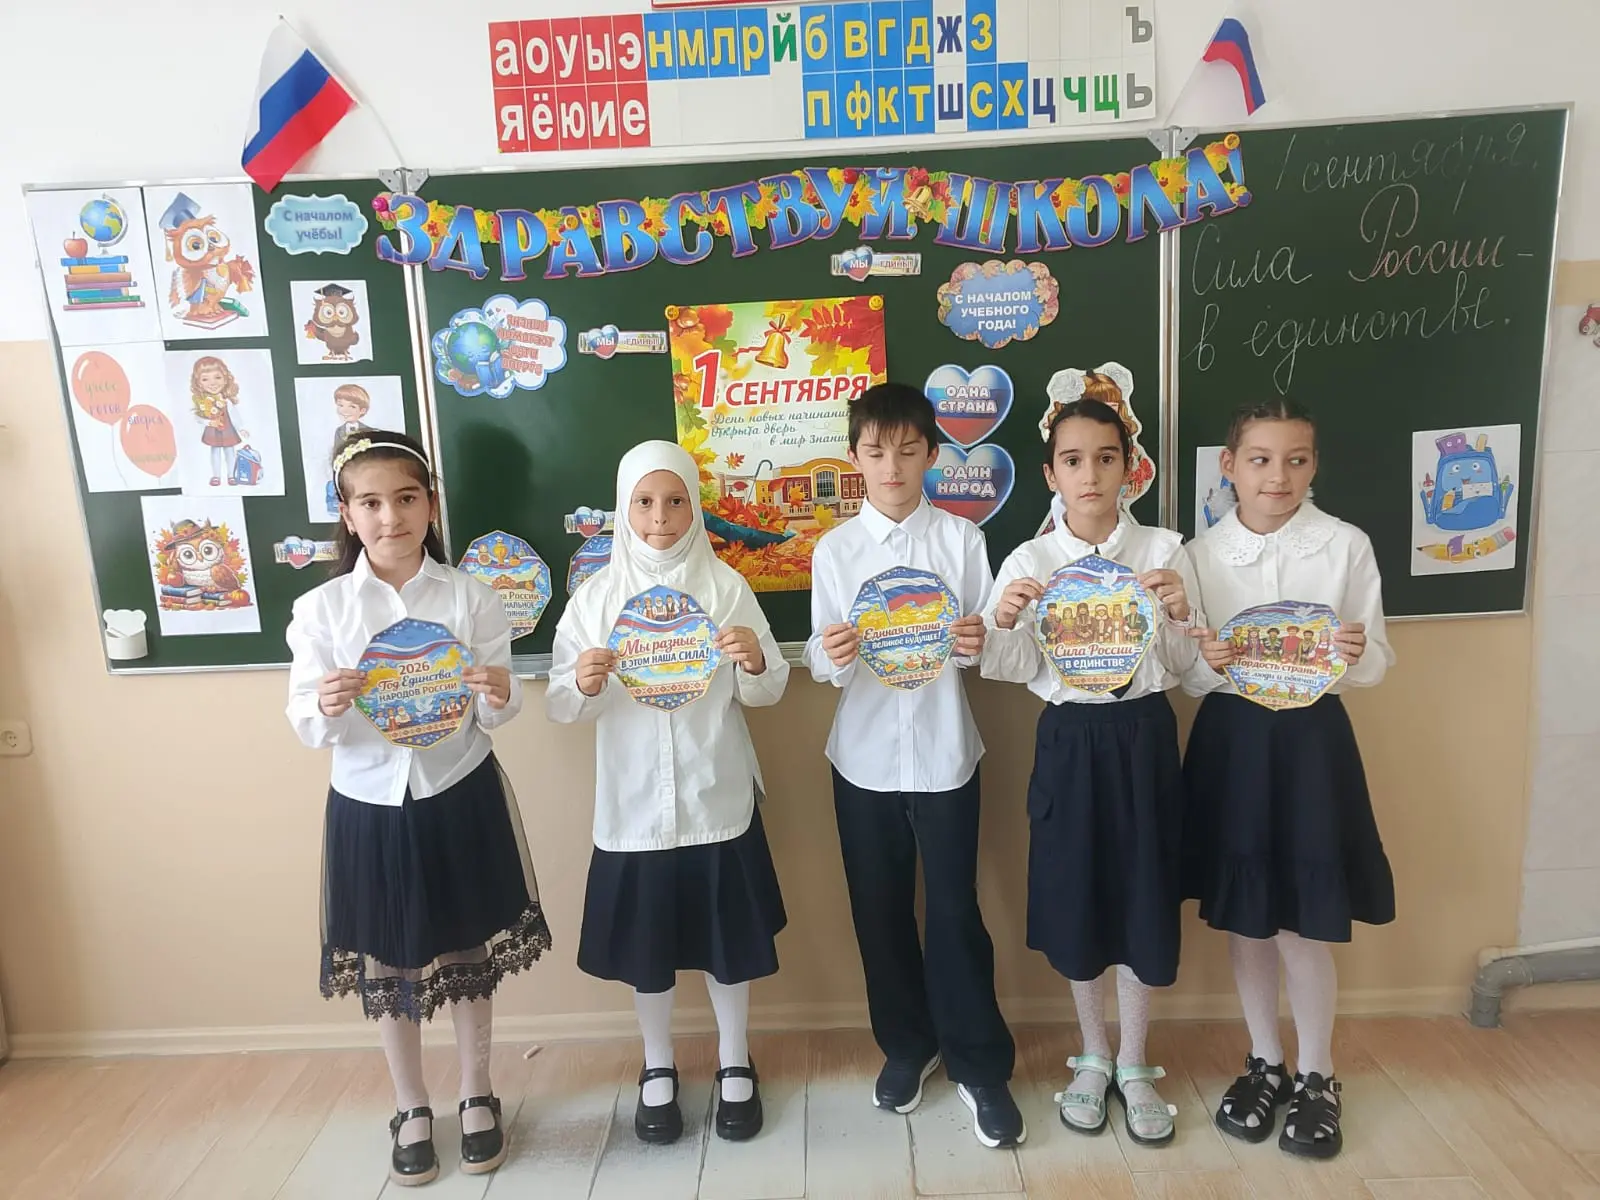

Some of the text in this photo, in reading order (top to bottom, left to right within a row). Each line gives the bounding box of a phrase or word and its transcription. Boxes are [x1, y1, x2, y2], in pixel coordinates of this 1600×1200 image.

[1275, 133, 1297, 191] 1
[284, 210, 354, 222] С началом
[377, 145, 1252, 281] ЗДРАВСТВУЙ ШКОЛА!
[296, 226, 343, 242] учёбы!
[1191, 223, 1313, 296] Сила
[1348, 183, 1504, 283] России
[850, 259, 868, 269] МЫ
[955, 290, 1032, 305] С НАЧАЛОМ
[960, 304, 1030, 318] УЧЕБНОГО
[978, 319, 1017, 332] ГОДА!
[596, 337, 615, 346] МЫ
[694, 352, 869, 408] 1 СЕНТЯБРЯ
[946, 385, 990, 398] ОДНА
[938, 399, 998, 413] СТРАНА
[711, 409, 850, 425] День новых начинани
[711, 421, 796, 440] Открыта дверь
[780, 437, 807, 448] мир
[809, 434, 850, 444] Знани
[942, 466, 991, 480] ОДИН
[936, 482, 996, 498] НАРОД
[582, 517, 601, 526] МЫ
[292, 547, 311, 556] МЫ
[905, 622, 941, 635] страна
[620, 639, 650, 657] Мы
[652, 636, 697, 654] разные
[1054, 644, 1086, 658] Сила
[1088, 644, 1133, 656] России
[629, 657, 650, 668] ЭТОМ
[652, 653, 677, 663] НАША
[678, 647, 710, 661] СИЛА!
[1073, 658, 1125, 670] единстве
[399, 661, 430, 675] 2026
[1281, 664, 1318, 675] страны
[378, 669, 452, 691] Год Единства
[379, 682, 457, 702] НАРОДОВ РОССИИ
